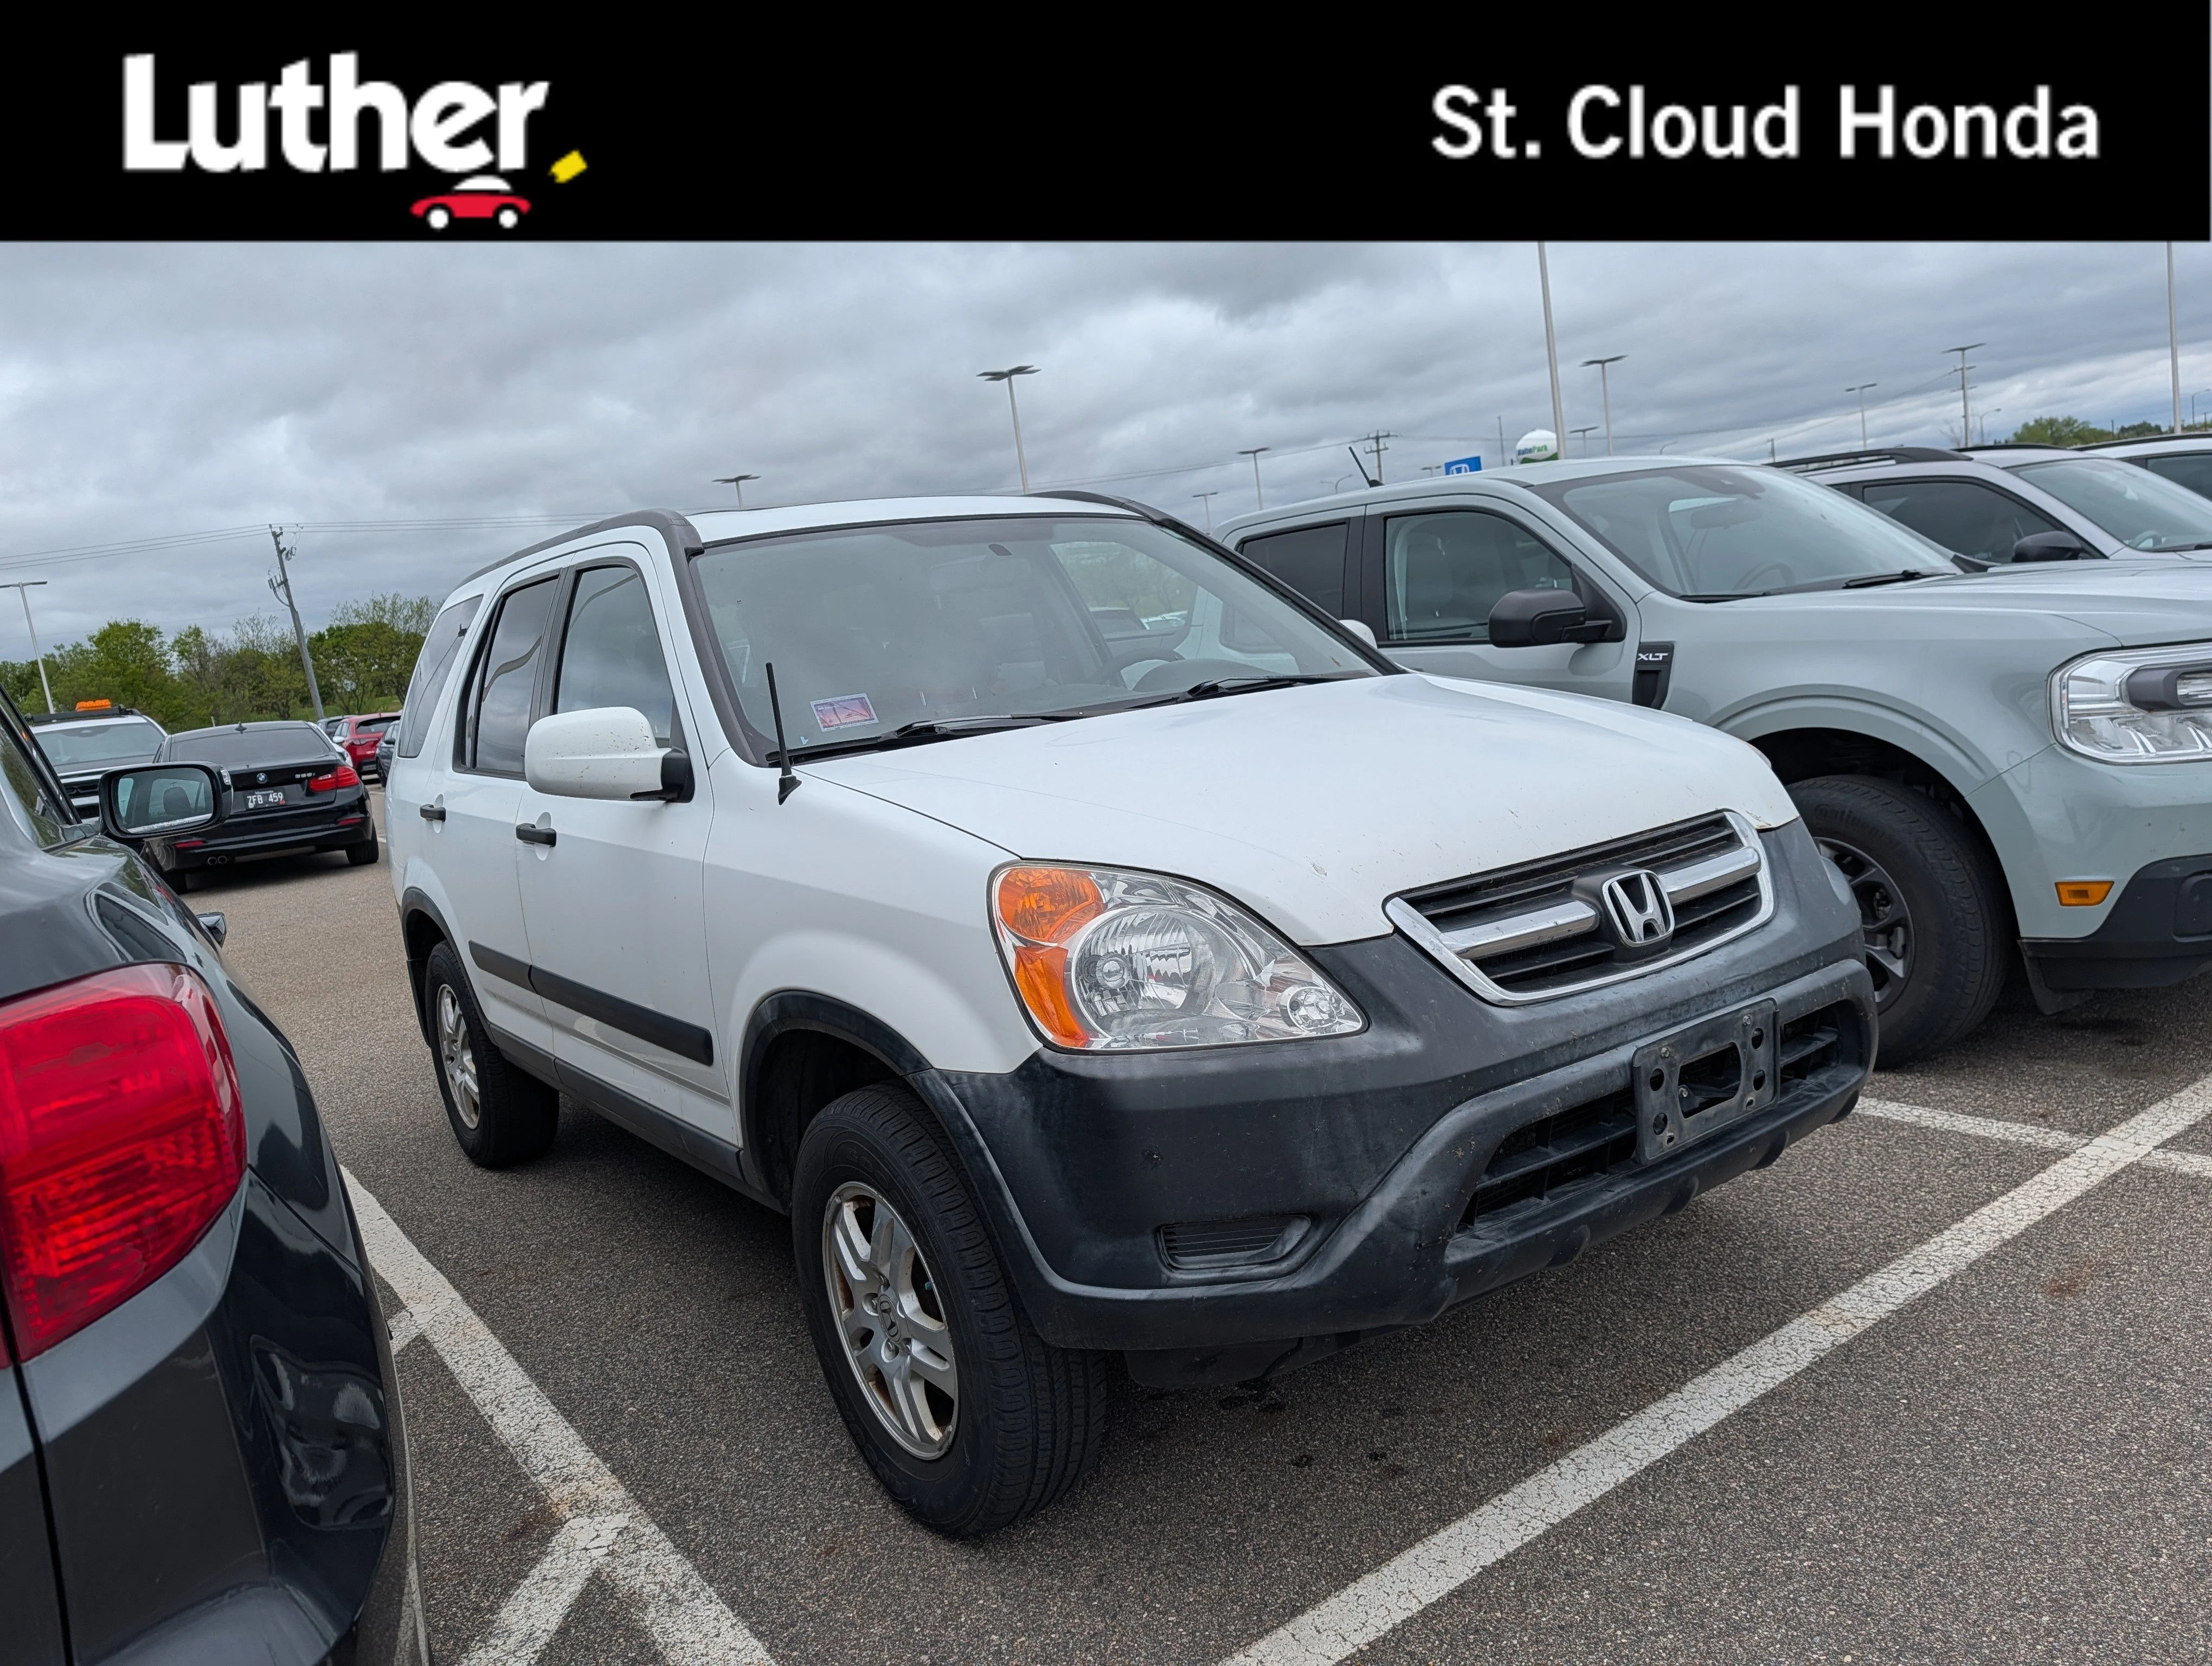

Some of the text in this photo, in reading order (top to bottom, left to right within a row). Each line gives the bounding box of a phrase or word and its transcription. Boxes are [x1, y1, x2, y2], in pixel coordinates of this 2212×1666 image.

[1637, 652, 1668, 661] XLT
[247, 794, 263, 805] ZFB
[268, 792, 283, 802] 459
